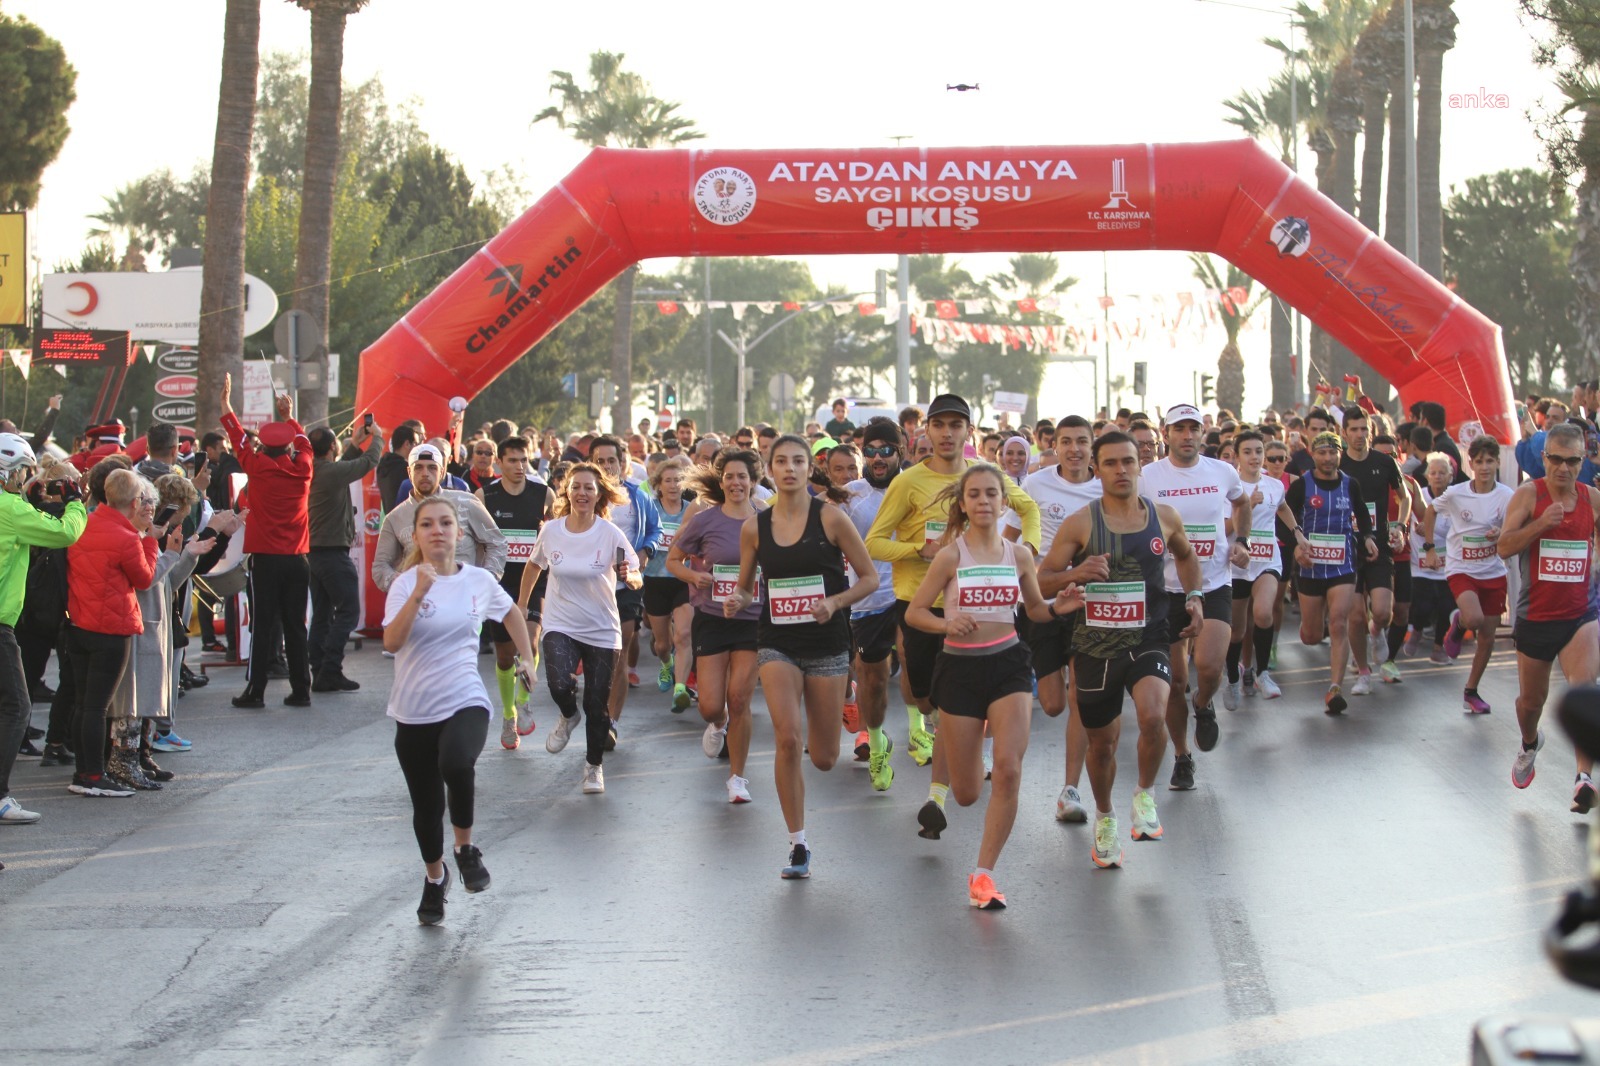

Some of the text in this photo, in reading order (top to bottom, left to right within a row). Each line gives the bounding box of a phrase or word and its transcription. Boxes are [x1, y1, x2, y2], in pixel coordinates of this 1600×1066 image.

[767, 160, 1078, 182] ATA'DAN ANA'YA
[814, 186, 1031, 207] SAYGI KOŞUSU
[866, 207, 979, 231] ÇIKIŞ
[1103, 211, 1151, 221] KARŞIYAKA
[465, 246, 582, 354] Chamartin
[1464, 545, 1496, 558] 35650
[1545, 559, 1583, 573] 36159
[963, 588, 1014, 604] 35043
[1093, 604, 1137, 619] 35271
